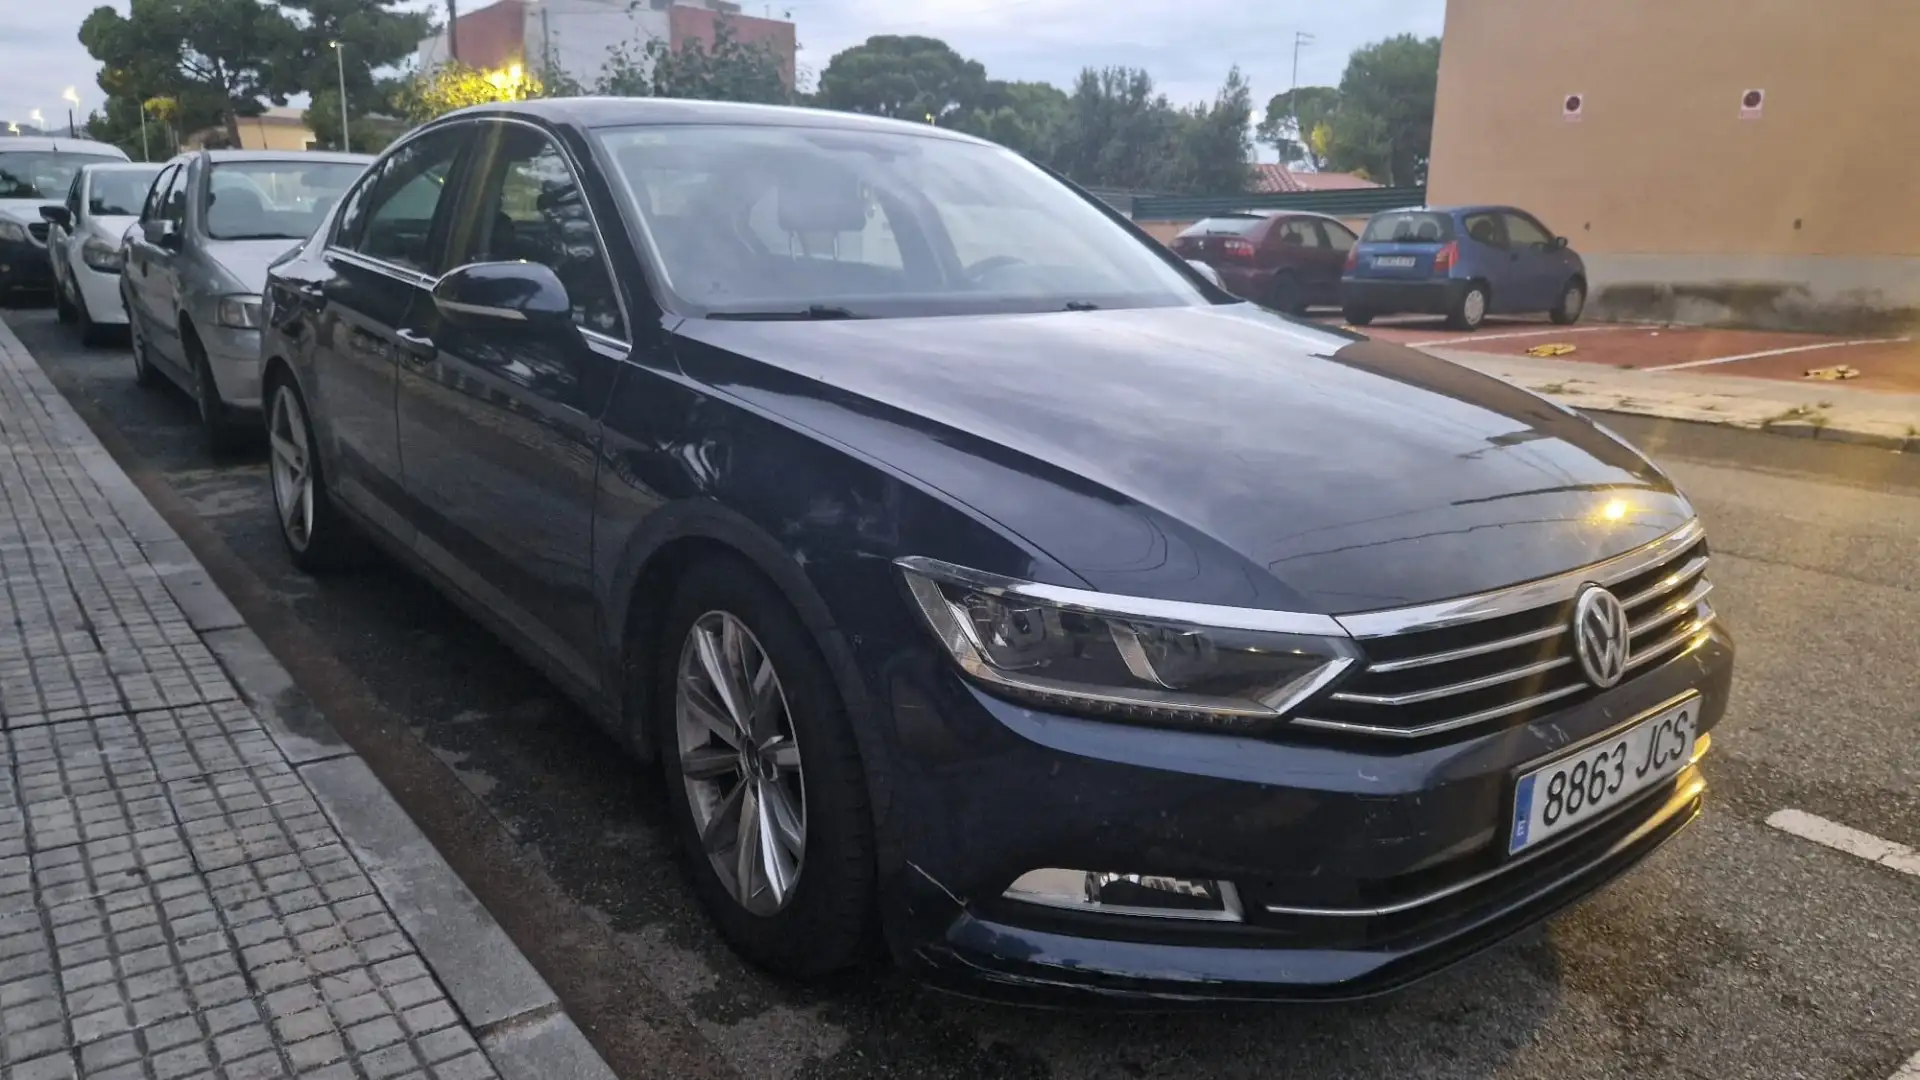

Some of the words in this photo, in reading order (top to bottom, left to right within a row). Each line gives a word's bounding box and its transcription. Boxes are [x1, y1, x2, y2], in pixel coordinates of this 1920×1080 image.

[1542, 740, 1627, 827] 8863
[1635, 709, 1689, 780] JCS
[1516, 819, 1525, 837] E
